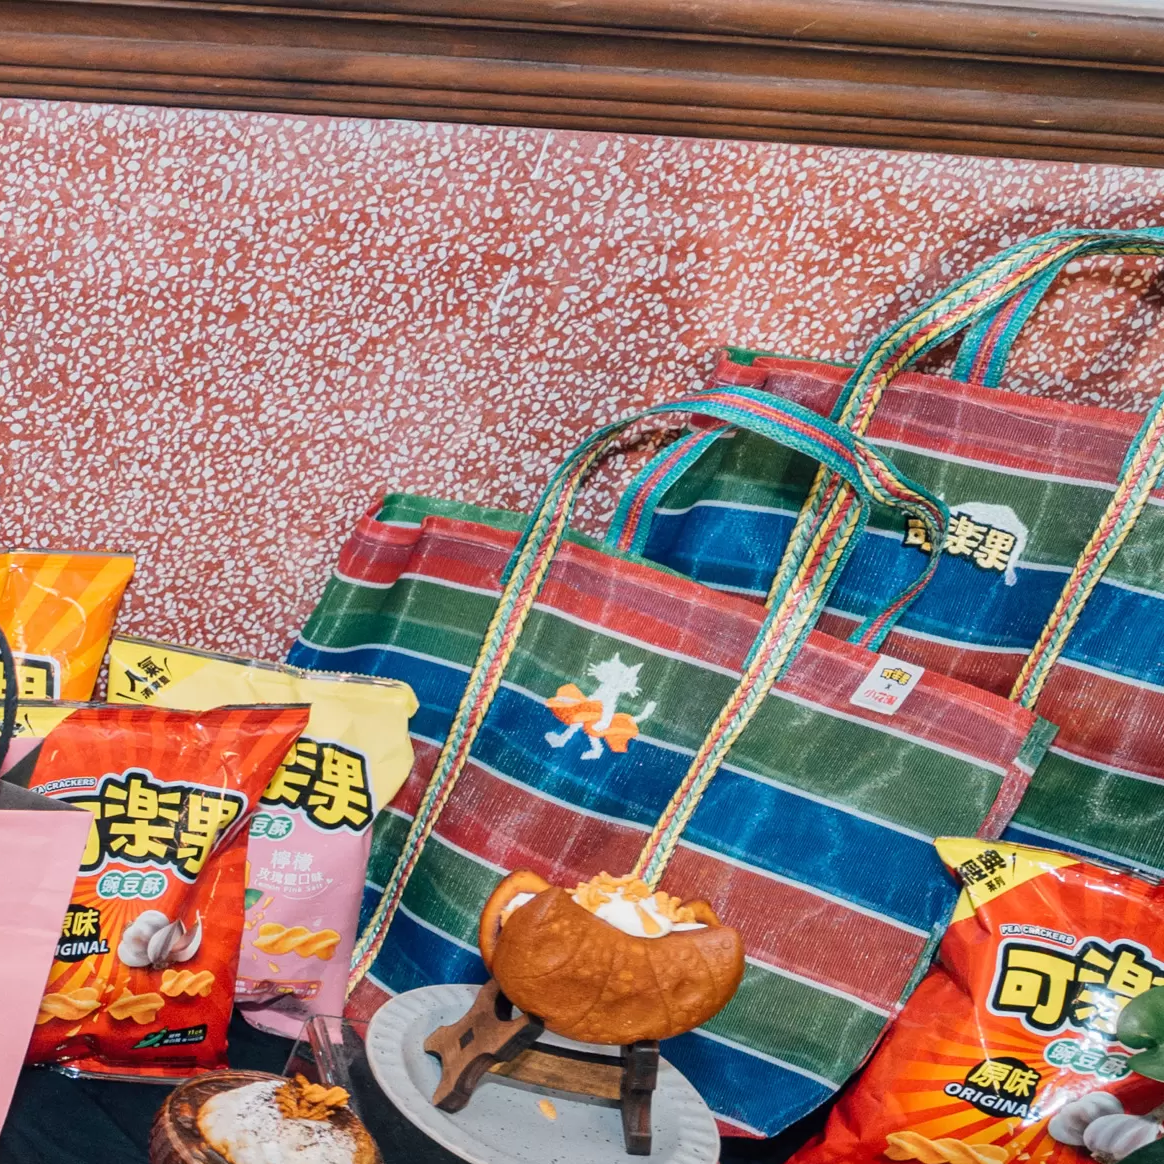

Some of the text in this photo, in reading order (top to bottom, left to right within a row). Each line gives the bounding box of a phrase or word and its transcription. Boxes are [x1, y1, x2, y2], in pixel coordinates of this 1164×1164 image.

[124, 656, 164, 692] 人氣
[47, 778, 96, 791] CRACKERS
[55, 939, 110, 957] IGINAL
[1000, 924, 1075, 945] PEA CRACKERS
[968, 1060, 1040, 1097] 原味
[944, 1082, 1040, 1121] ORIGINA
